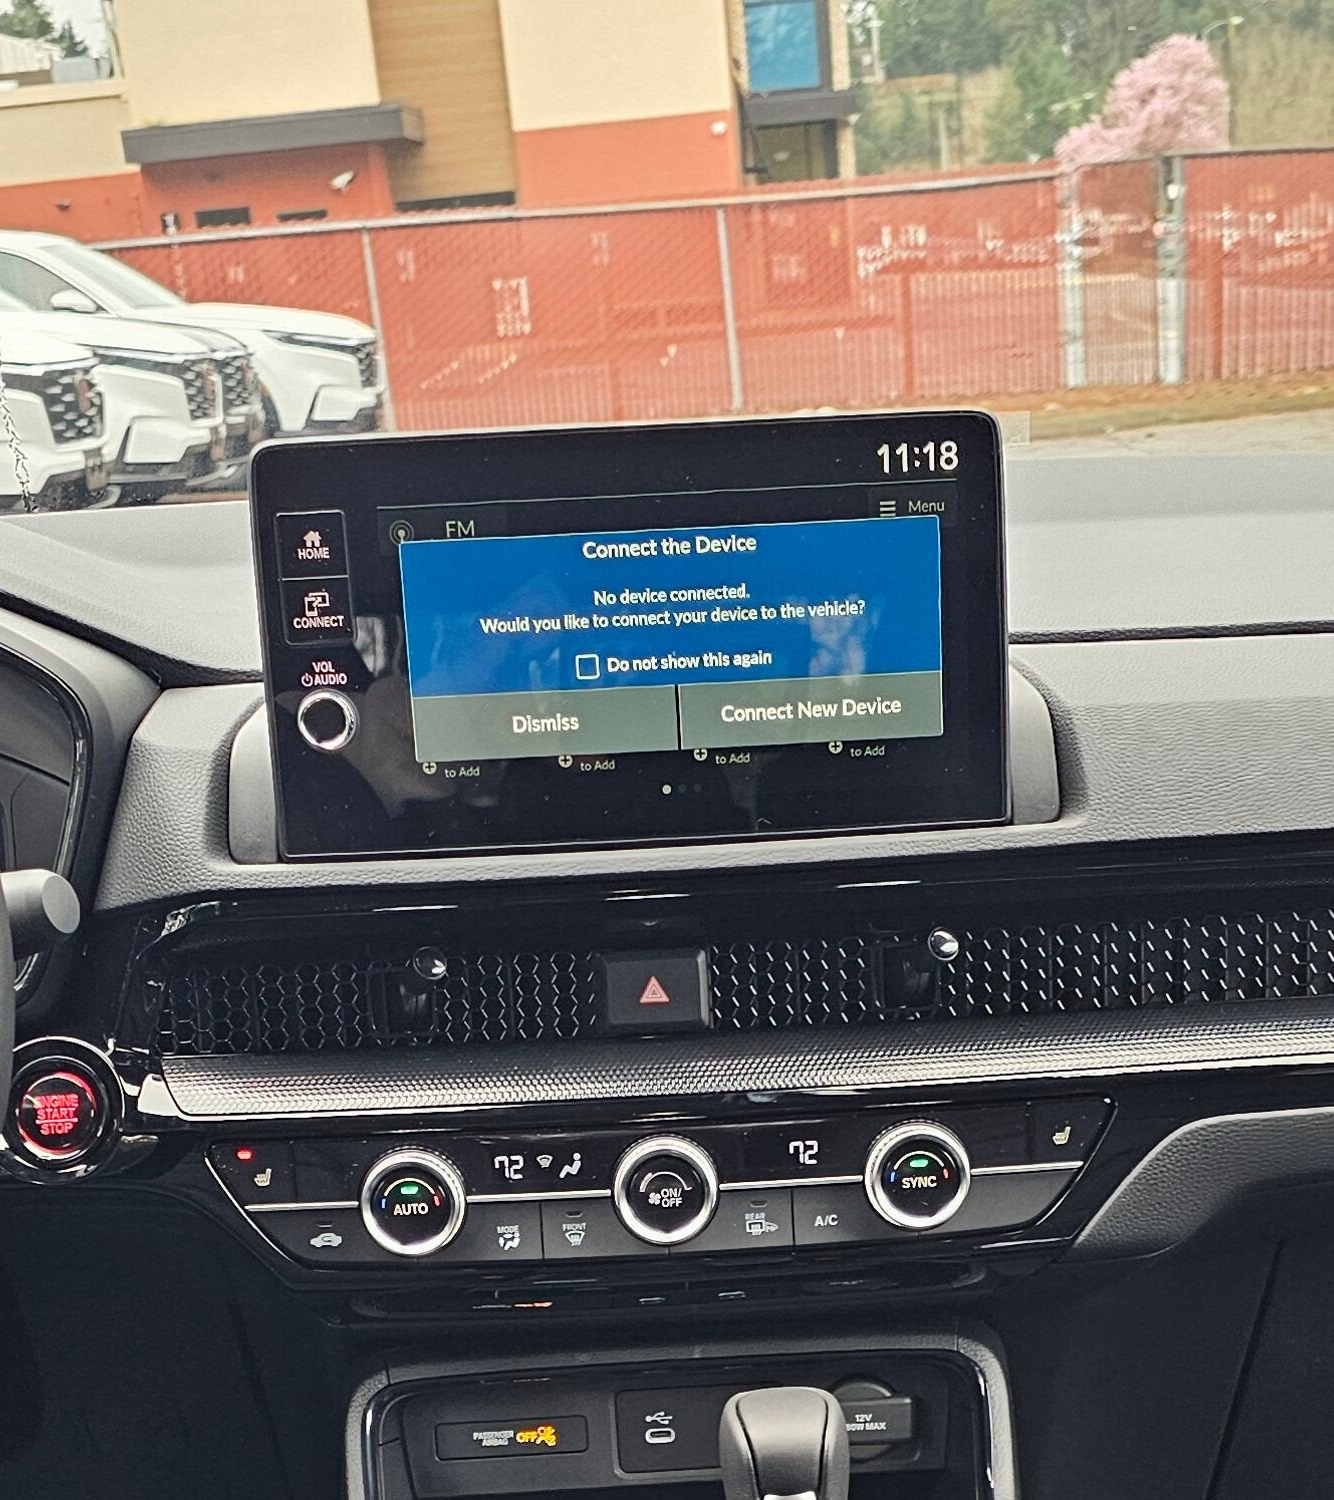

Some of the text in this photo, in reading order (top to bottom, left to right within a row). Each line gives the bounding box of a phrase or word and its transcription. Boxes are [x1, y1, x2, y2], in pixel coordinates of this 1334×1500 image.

[876, 440, 959, 474] 11:18
[908, 500, 945, 513] Menu
[445, 520, 475, 538] FM
[582, 534, 757, 559] Connect the Device
[297, 547, 330, 560] HOME
[593, 583, 751, 606] No device connected.
[293, 615, 345, 629] CONNECT
[480, 600, 865, 635] Would you like to connect your device to the vehicle?
[312, 661, 335, 673] VOL
[607, 650, 772, 673] Do not show this again
[314, 672, 348, 686] AUDIO
[720, 696, 902, 722] Connect New Device
[511, 712, 580, 734] Dismiss
[850, 745, 885, 757] to Add
[715, 753, 751, 765] to Add
[444, 766, 481, 778] to Add
[580, 760, 616, 772] to Add
[34, 1093, 79, 1109] ENGINE
[37, 1107, 76, 1120] START
[40, 1122, 74, 1135] STOP
[789, 1141, 818, 1165] 72
[494, 1155, 524, 1180] 72
[901, 1175, 937, 1189] SYNC
[660, 1187, 682, 1199] ON/
[661, 1196, 683, 1208] OFF
[393, 1202, 429, 1216] AUTO
[744, 1212, 765, 1222] REAR
[814, 1214, 838, 1228] A/C
[497, 1225, 520, 1234] MODE
[562, 1222, 587, 1232] FRONT
[855, 1413, 873, 1422] 12V
[865, 1422, 887, 1431] MAX
[516, 1431, 538, 1443] OFF
